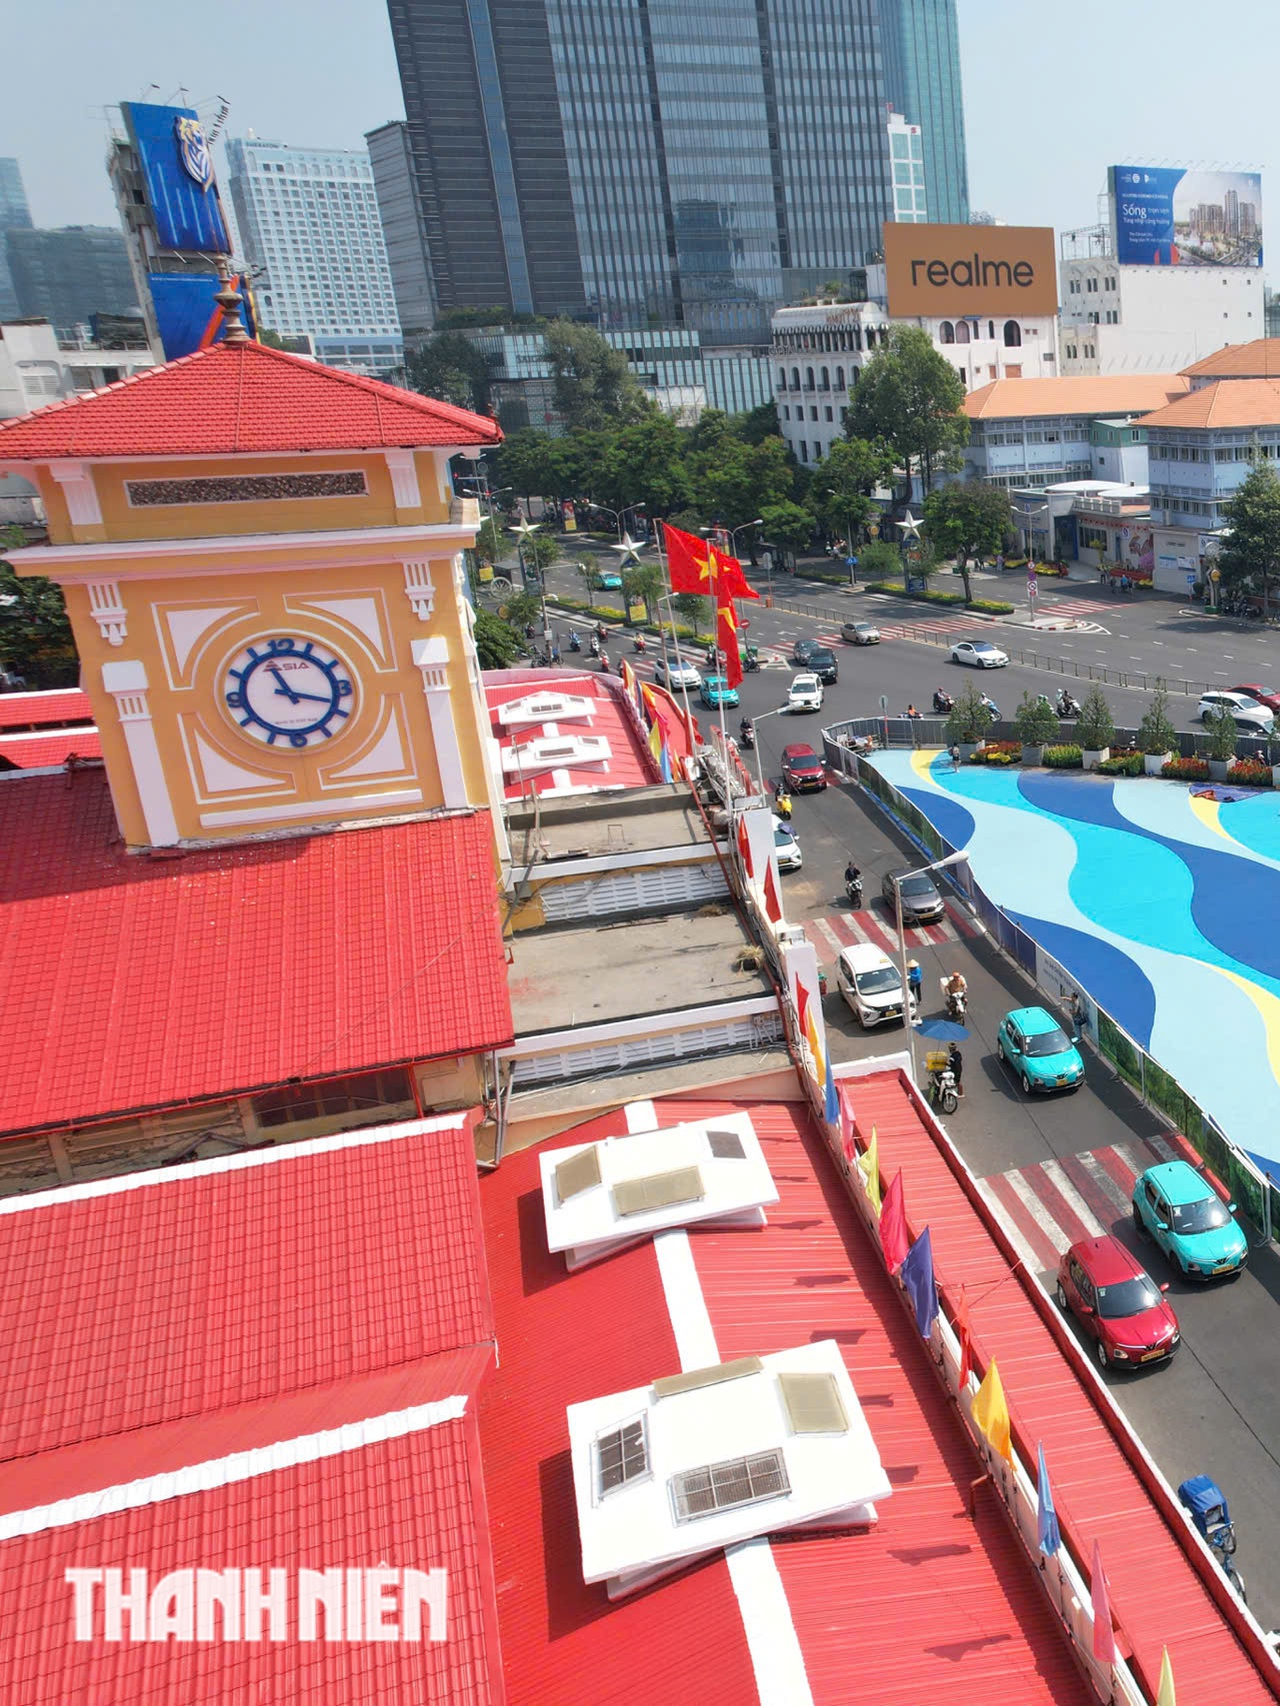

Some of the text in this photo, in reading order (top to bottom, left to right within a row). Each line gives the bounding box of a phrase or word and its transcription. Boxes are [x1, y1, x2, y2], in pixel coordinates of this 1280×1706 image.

[1122, 203, 1147, 219] Sống
[911, 253, 1034, 287] realme
[262, 660, 310, 672] ASIA
